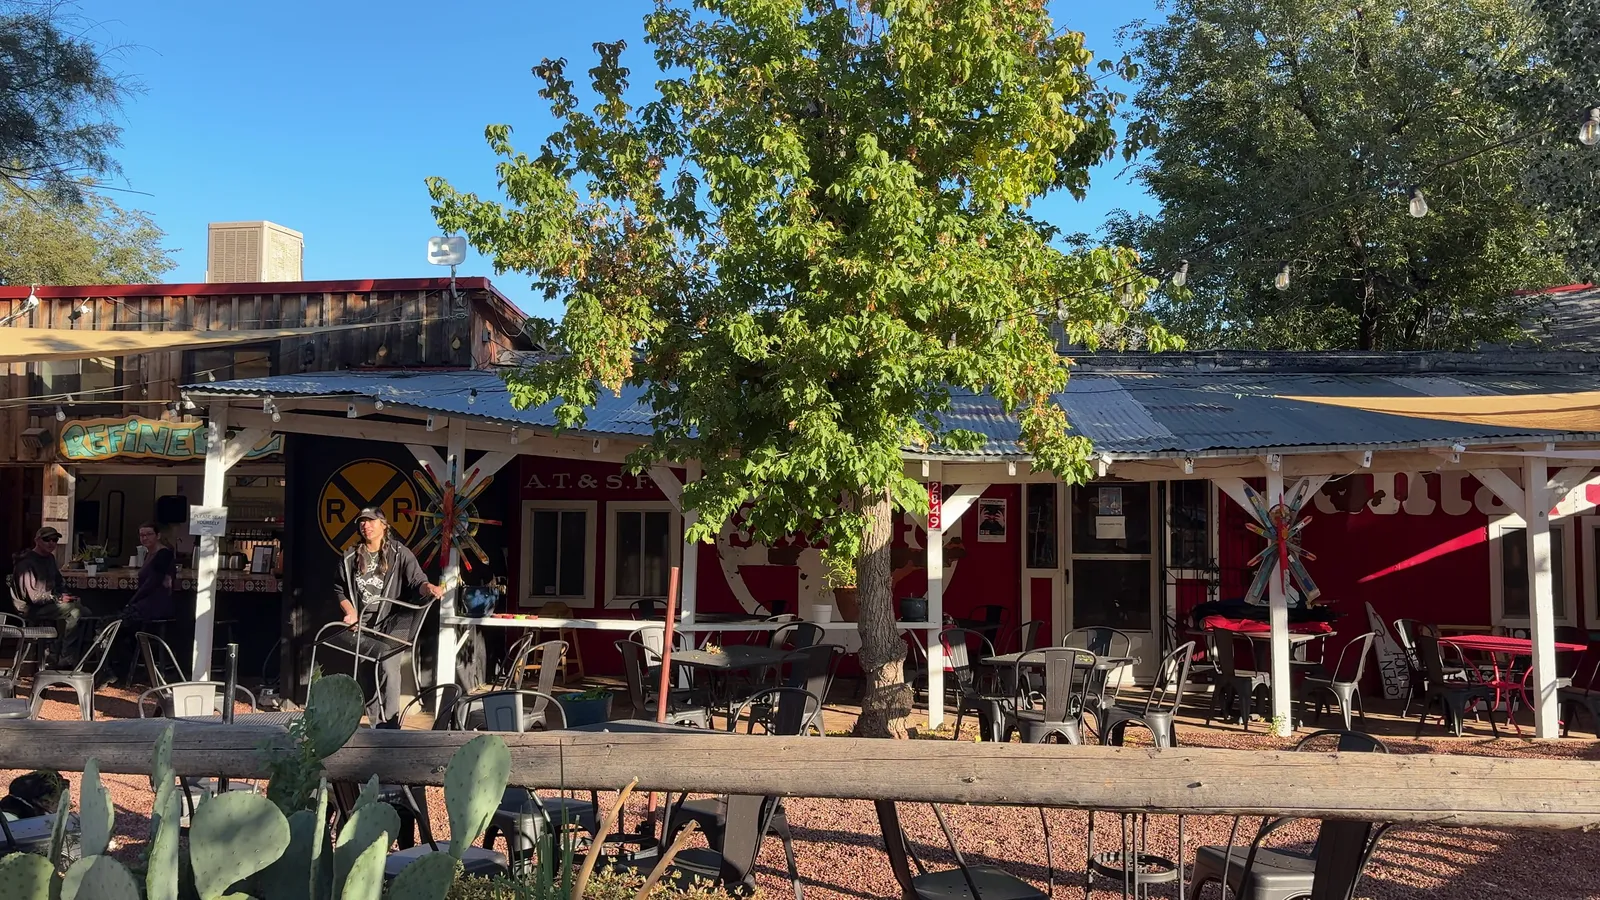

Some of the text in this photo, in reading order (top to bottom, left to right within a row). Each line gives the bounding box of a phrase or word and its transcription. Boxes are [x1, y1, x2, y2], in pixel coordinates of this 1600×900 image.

[929, 482, 940, 528] 2849
[1381, 661, 1399, 696] OPEN
[1393, 653, 1409, 689] LUNCH
